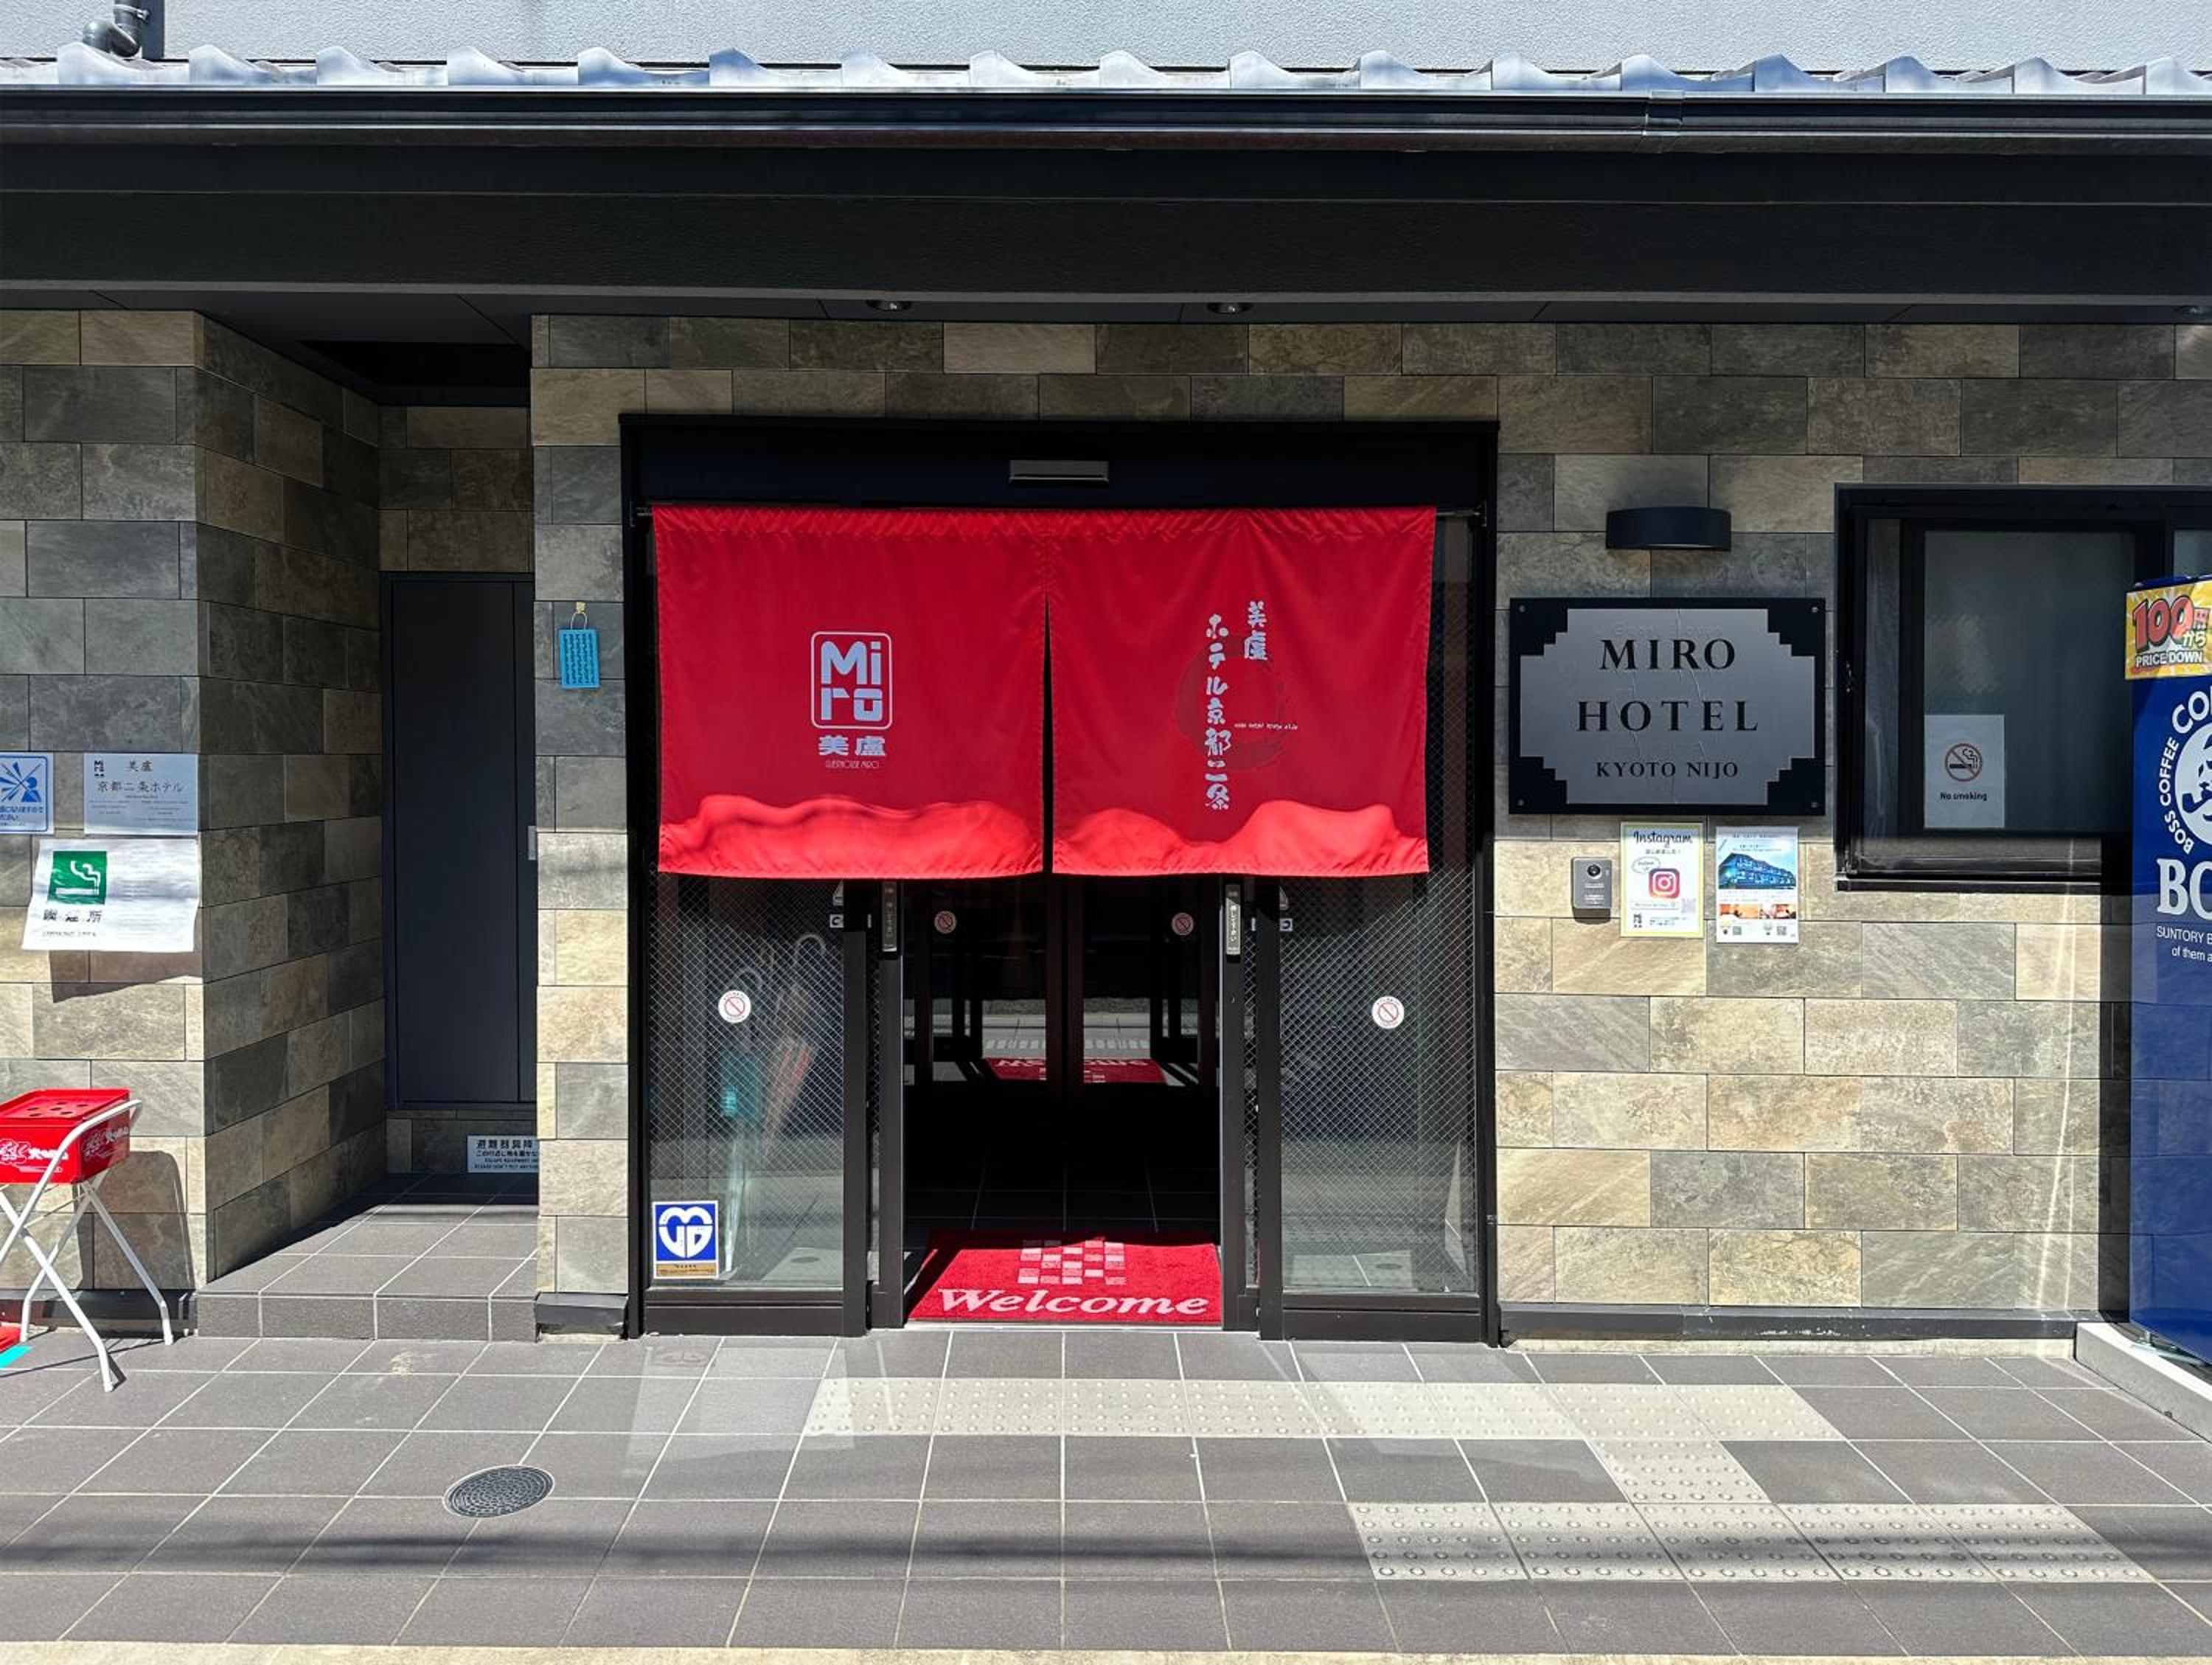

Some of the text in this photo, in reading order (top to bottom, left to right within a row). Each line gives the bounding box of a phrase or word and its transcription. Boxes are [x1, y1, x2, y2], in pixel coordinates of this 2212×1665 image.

[1599, 638, 1736, 670] MIRO
[2135, 650, 2203, 667] PRICE DOWN
[1576, 700, 1759, 732] HOTEL
[2171, 686, 2212, 734] CO
[1596, 762, 1739, 779] KYOTO NIJO
[1940, 791, 1987, 802] No smoking
[2159, 737, 2194, 855] BOSS COFFEE
[1633, 830, 1694, 849] Instagram
[2157, 926, 2205, 944] SUNTORY
[2171, 945, 2180, 956] of
[2183, 948, 2205, 961] them
[938, 1288, 1209, 1314] Welcome
